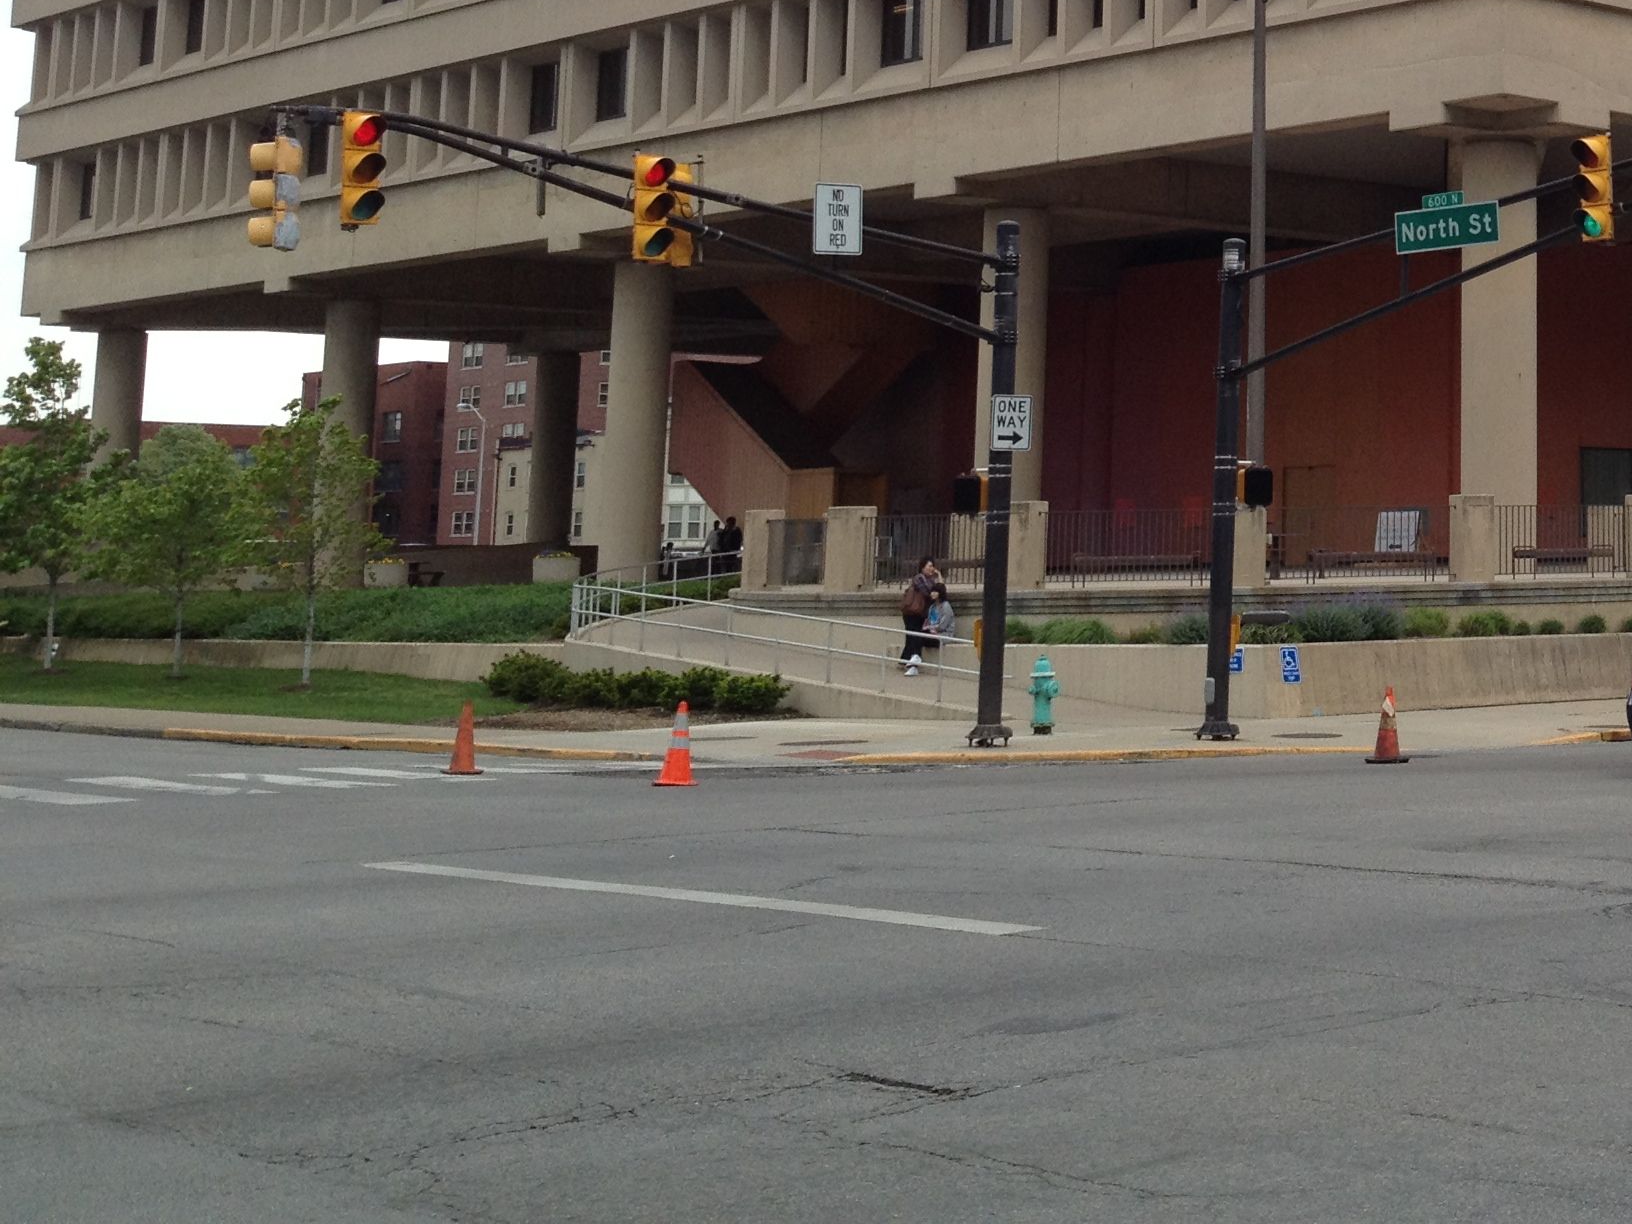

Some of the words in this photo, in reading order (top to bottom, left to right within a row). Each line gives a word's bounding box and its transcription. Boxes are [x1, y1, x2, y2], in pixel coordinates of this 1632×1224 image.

[832, 190, 844, 201] NO
[1427, 196, 1447, 208] 600
[1451, 194, 1458, 205] N
[828, 204, 849, 217] TURN
[832, 219, 844, 232] ON
[1401, 218, 1460, 243] North
[1469, 213, 1492, 235] St
[829, 234, 847, 247] RED
[998, 400, 1027, 413] ONE
[997, 415, 1028, 428] WAY
